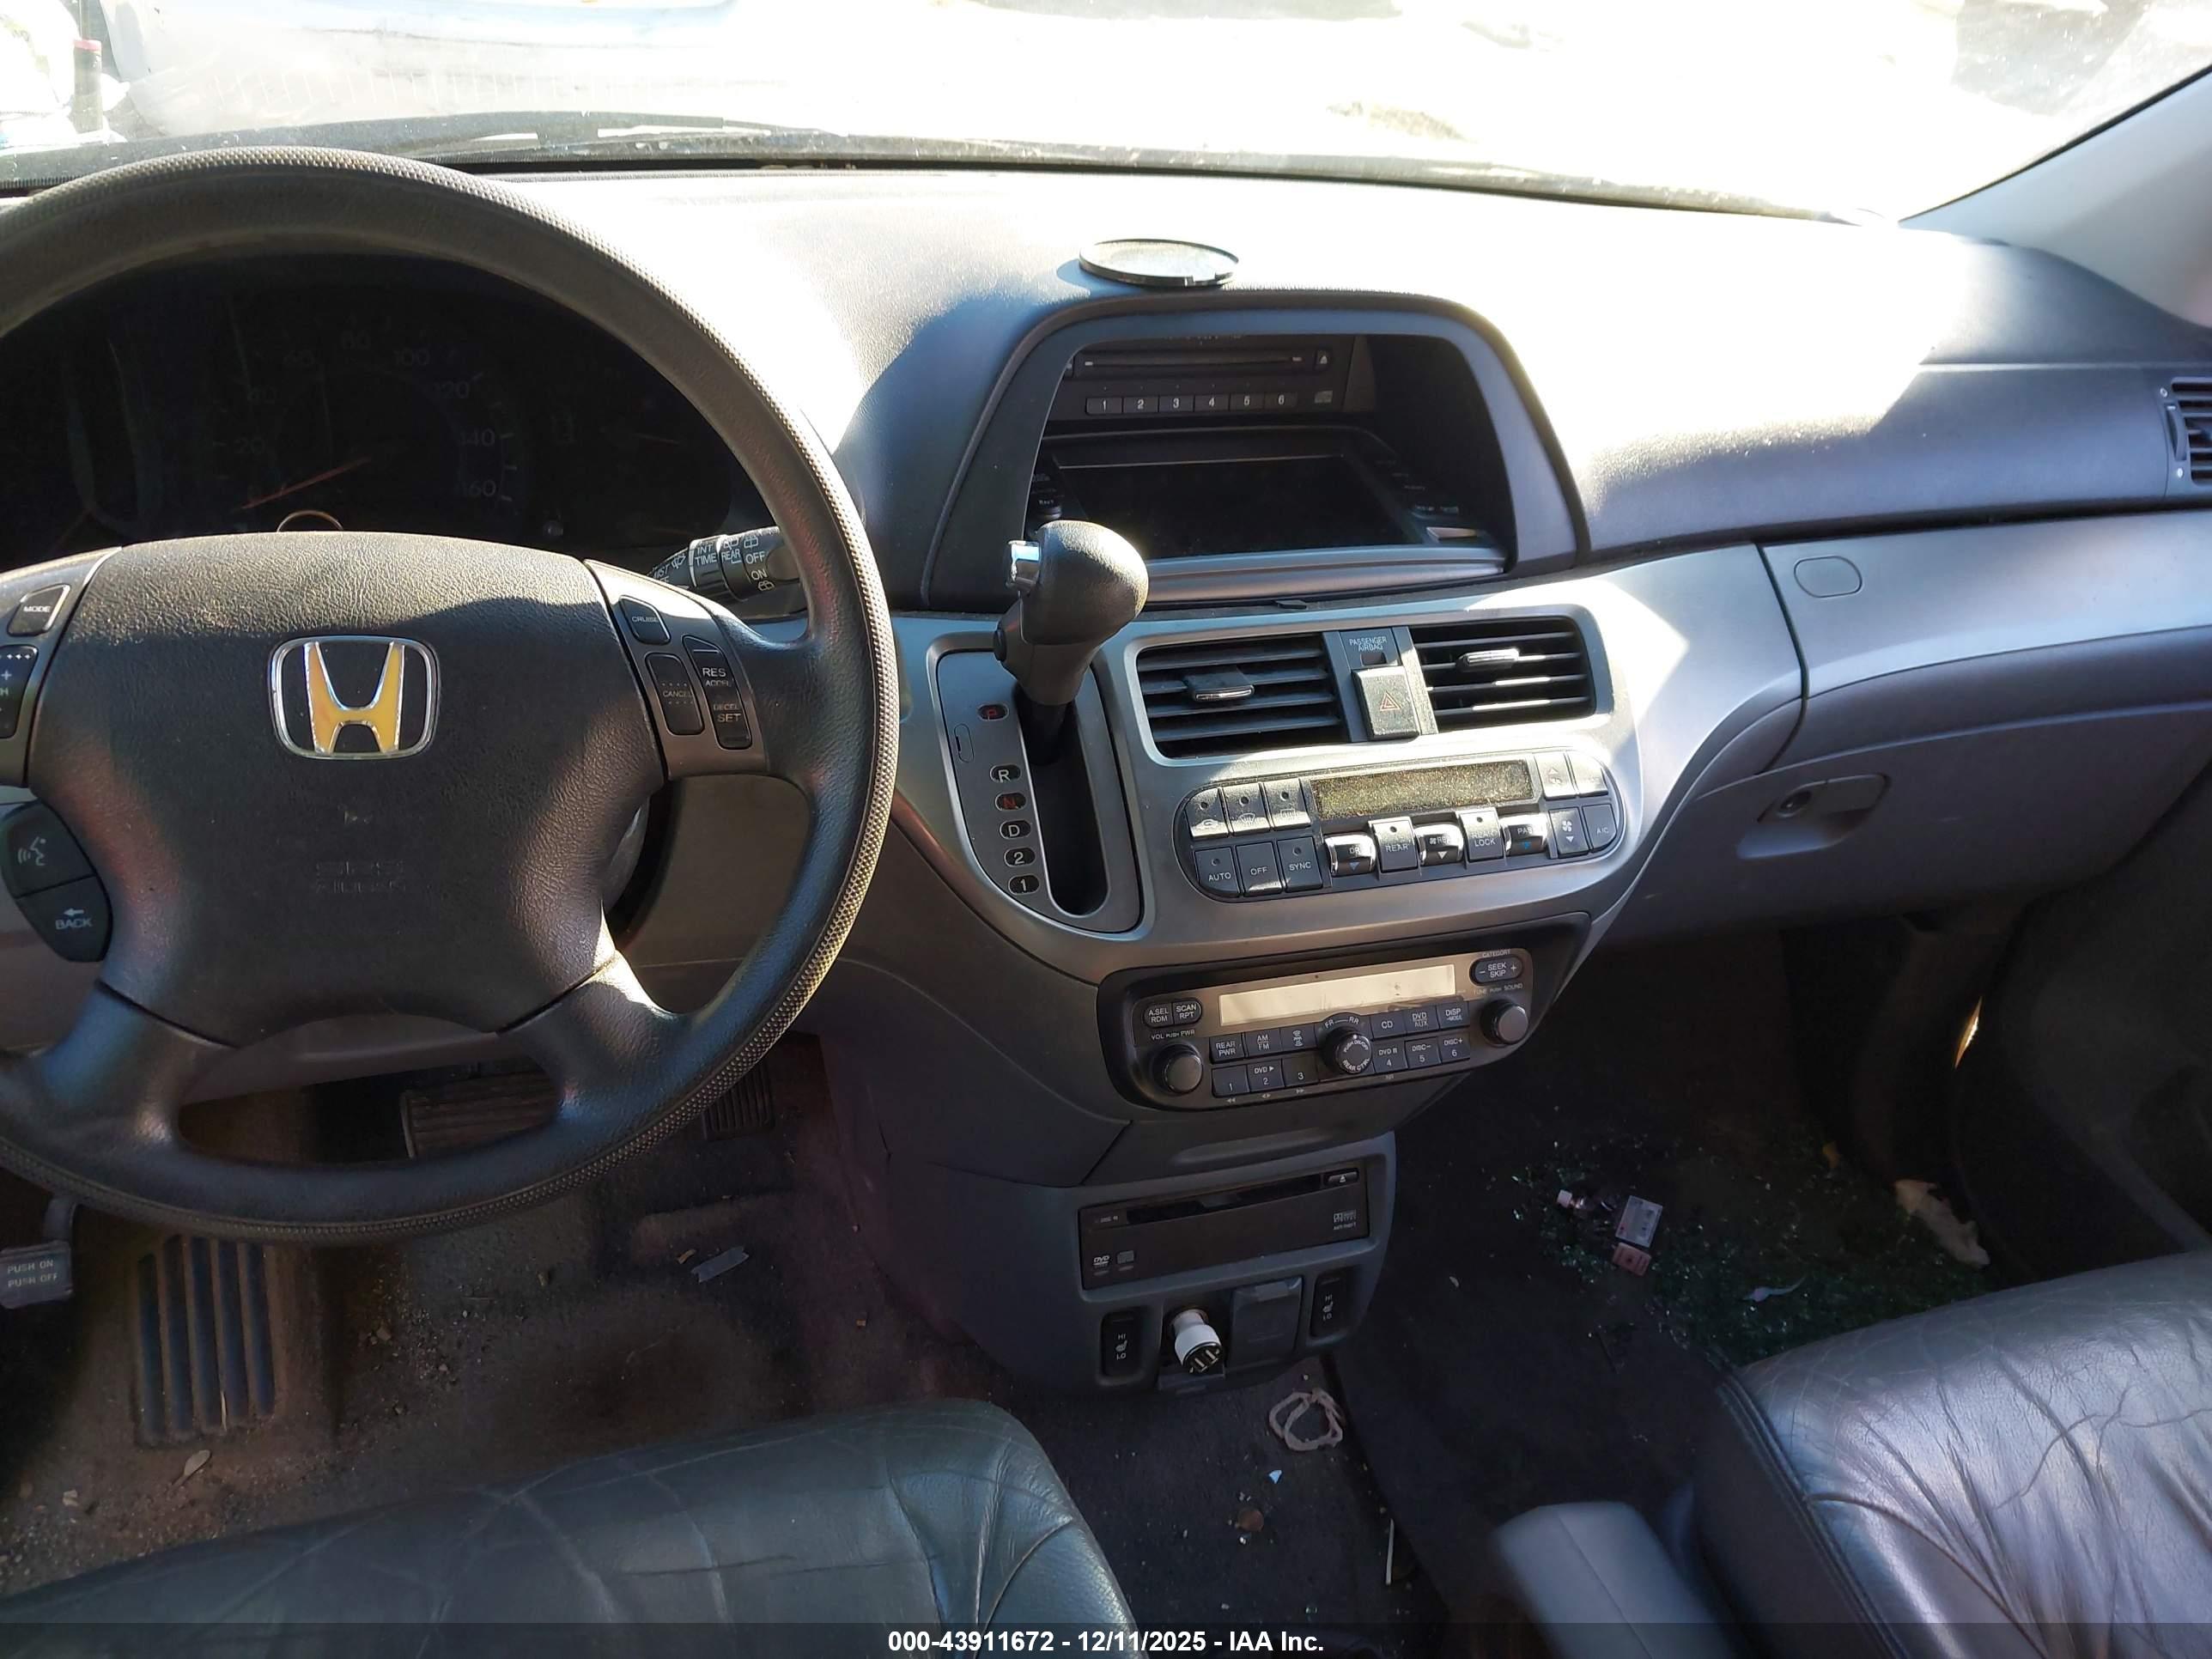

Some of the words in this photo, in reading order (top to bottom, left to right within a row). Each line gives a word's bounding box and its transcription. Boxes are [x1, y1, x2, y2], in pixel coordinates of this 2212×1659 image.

[1102, 399, 1108, 410] 1
[1137, 398, 1145, 410] 2
[1172, 398, 1180, 409] 3
[1209, 397, 1215, 407] 4
[1243, 395, 1250, 405] 5
[1278, 394, 1285, 405] 6
[458, 427, 495, 447] 140
[233, 437, 266, 455] 20
[455, 478, 498, 498] 160
[696, 544, 714, 556] INT
[720, 549, 741, 562] REAR
[694, 552, 718, 567] TIME
[744, 551, 766, 564] OFF
[750, 568, 769, 581] ON
[1349, 636, 1388, 647] PASSENGER
[1358, 643, 1384, 653] AIRBAG
[702, 667, 727, 678] RES
[662, 690, 694, 699] CANCEL
[717, 714, 743, 723] SET
[997, 769, 1011, 782] R
[1003, 797, 1018, 809] N
[1008, 824, 1021, 837] D
[1385, 842, 1409, 853] REAR
[1474, 838, 1496, 848] LOCK
[1013, 851, 1024, 865] 2
[1250, 866, 1268, 876] OFF
[1288, 861, 1311, 872] SYNC
[1208, 872, 1231, 882] AUTO
[1020, 878, 1028, 891] 1
[55, 918, 94, 930] BACK
[1482, 949, 1511, 957] CATEGORY
[1487, 963, 1507, 971] SEEK
[1490, 969, 1506, 978] SKIP
[1149, 1008, 1169, 1017] A.SEL
[1176, 1004, 1196, 1012] SCAN
[1445, 1007, 1462, 1017] DISP
[1412, 1012, 1427, 1020] DVD
[1325, 1019, 1334, 1029] FR
[1349, 1016, 1359, 1024] RR
[1381, 1020, 1394, 1029] CD
[1216, 1041, 1236, 1050] REAR
[1218, 1048, 1237, 1057] PWR
[1386, 1059, 1392, 1067] 4
[1262, 1077, 1269, 1085] 2
[1297, 1072, 1304, 1080] 3
[1228, 1083, 1234, 1091] 1
[7, 1262, 35, 1274] PUSH
[40, 1259, 54, 1269] ON
[8, 1277, 35, 1288] PUSH
[40, 1273, 58, 1282] OFF
[1325, 1294, 1333, 1303] HI
[1116, 1352, 1127, 1361] LO
